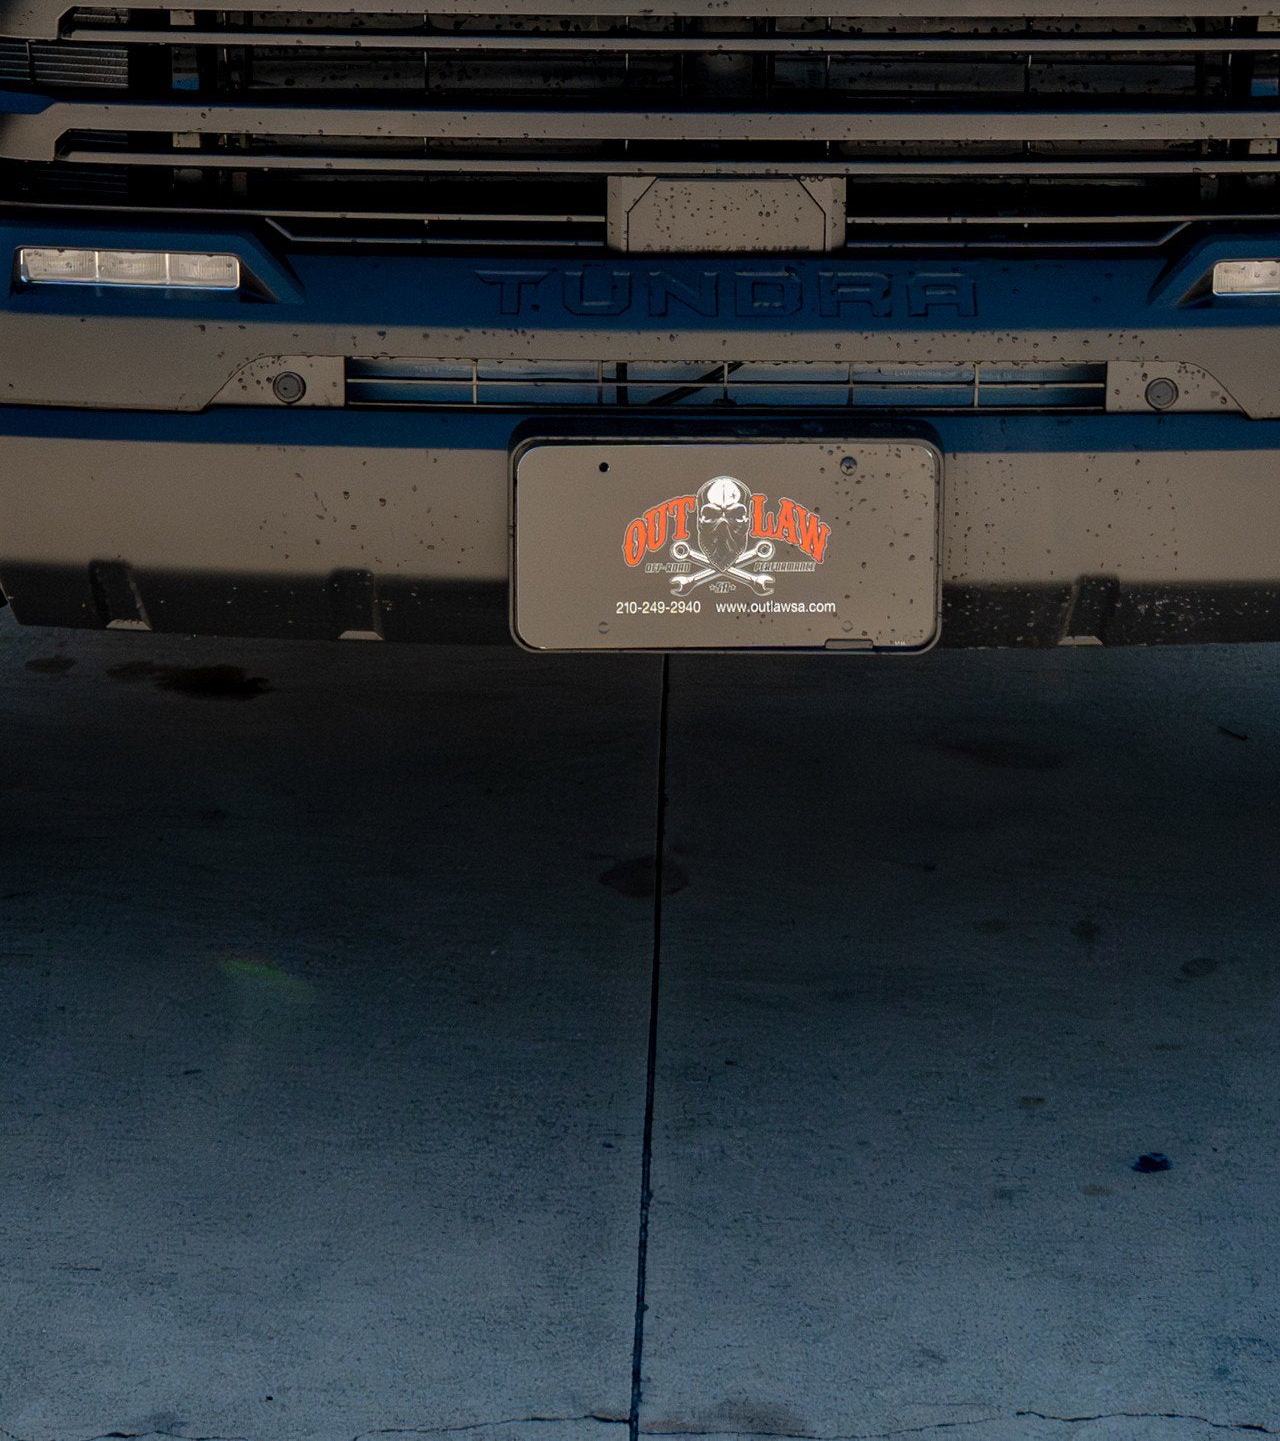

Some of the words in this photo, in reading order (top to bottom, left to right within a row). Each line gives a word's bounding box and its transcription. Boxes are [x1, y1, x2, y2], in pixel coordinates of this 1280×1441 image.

[472, 269, 979, 318] TUNDRA
[644, 562, 691, 573] OFF-ROAD
[753, 562, 816, 573] PERFORMANCE
[616, 600, 701, 614] 210-249-2940
[716, 600, 836, 613] www.outlawsa.com
